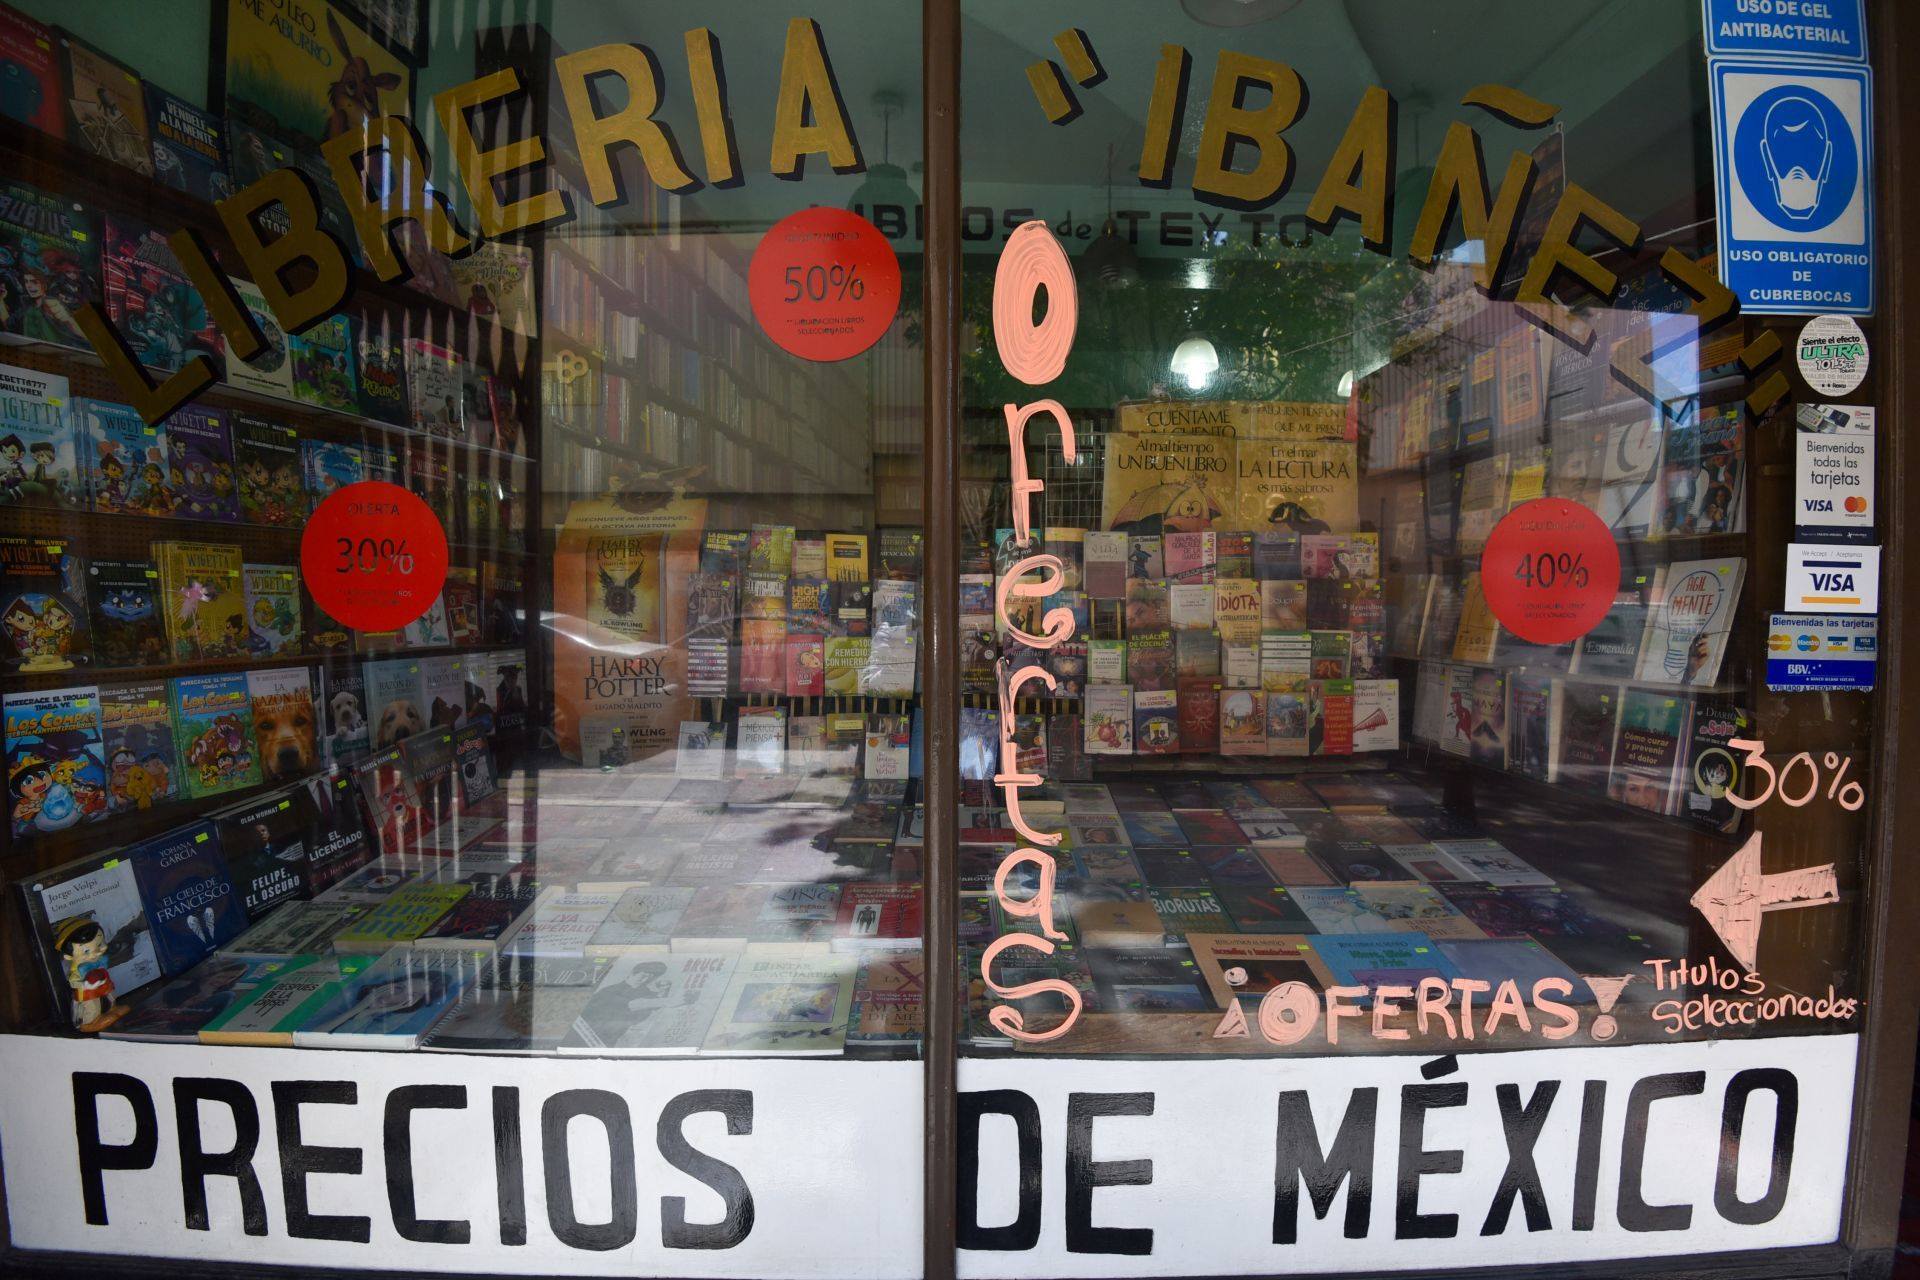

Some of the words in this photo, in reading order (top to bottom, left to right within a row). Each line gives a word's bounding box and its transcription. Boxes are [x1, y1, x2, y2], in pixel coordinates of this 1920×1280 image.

[1737, 0, 1771, 13] USO
[1776, 1, 1797, 16] DE
[1801, 3, 1832, 19] GEL
[269, 13, 332, 68] ABURRO
[1720, 22, 1850, 45] ANTIBACTERIAL
[78, 17, 866, 428] LIBRERIA
[1056, 205, 1092, 241] de
[1730, 250, 1763, 262] USO
[1767, 250, 1868, 266] OBLIGATORIO
[784, 264, 865, 304] 50%
[1792, 271, 1812, 282] DE
[1750, 289, 1852, 303] CUBREBOCAS
[1802, 337, 1827, 346] Siente
[1836, 335, 1860, 344] efecto
[1801, 342, 1865, 362] ULTRA
[1297, 423, 1313, 433] ME
[1136, 439, 1149, 453] Al
[1150, 438, 1169, 453] mal
[1170, 440, 1215, 456] tiempo
[1271, 446, 1287, 458] En
[1288, 445, 1297, 458] el
[1299, 449, 1318, 458] mar
[1807, 440, 1865, 454] Bienvenidas
[1118, 454, 1144, 470] UN
[1144, 455, 1186, 472] BUEN
[1186, 456, 1228, 473] LIBRO
[1240, 460, 1263, 479] LA
[1268, 460, 1350, 480] LECTURA
[1813, 456, 1841, 468] todas
[1844, 456, 1858, 468] las
[1257, 484, 1269, 494] es
[1270, 481, 1293, 494] más
[1294, 482, 1335, 494] sabrosa
[1811, 470, 1860, 490] tarjetas
[1803, 499, 1834, 512] VISA
[336, 537, 414, 574] 30%
[597, 546, 649, 562] POTTER
[1516, 552, 1590, 589] 40%
[792, 586, 820, 595] HIGH
[1808, 573, 1855, 592] VISA
[1671, 592, 1715, 617] MENTE
[1772, 616, 1824, 627] Bienvenidas
[1826, 618, 1839, 627] las
[1842, 618, 1874, 629] tarjetas
[587, 655, 668, 678] HARRY
[584, 677, 673, 700] POTTER
[594, 702, 626, 711] LEGADO
[627, 702, 663, 710] MALDITO
[1631, 743, 1665, 756] prevenir
[1645, 736, 1669, 748] curar
[1636, 753, 1659, 765] dolor
[1725, 738, 1865, 811] 30%
[240, 813, 256, 825] OLGA
[327, 830, 340, 842] EL
[309, 831, 363, 862] LICENCIADO
[48, 889, 73, 905] Jorge
[74, 879, 99, 893] Volpi
[51, 903, 67, 914] Una
[67, 894, 92, 908] novela
[93, 881, 121, 898] criminal
[163, 896, 176, 908] EL
[176, 885, 205, 903] CIELO
[205, 878, 218, 890] DE
[246, 894, 259, 909] EL
[261, 875, 300, 902] OSCURO
[156, 882, 231, 924] FRANCESCO
[72, 1070, 756, 1251] PRECIOS
[958, 1087, 1155, 1254] DE
[1272, 1054, 1799, 1245] MÉXICO
